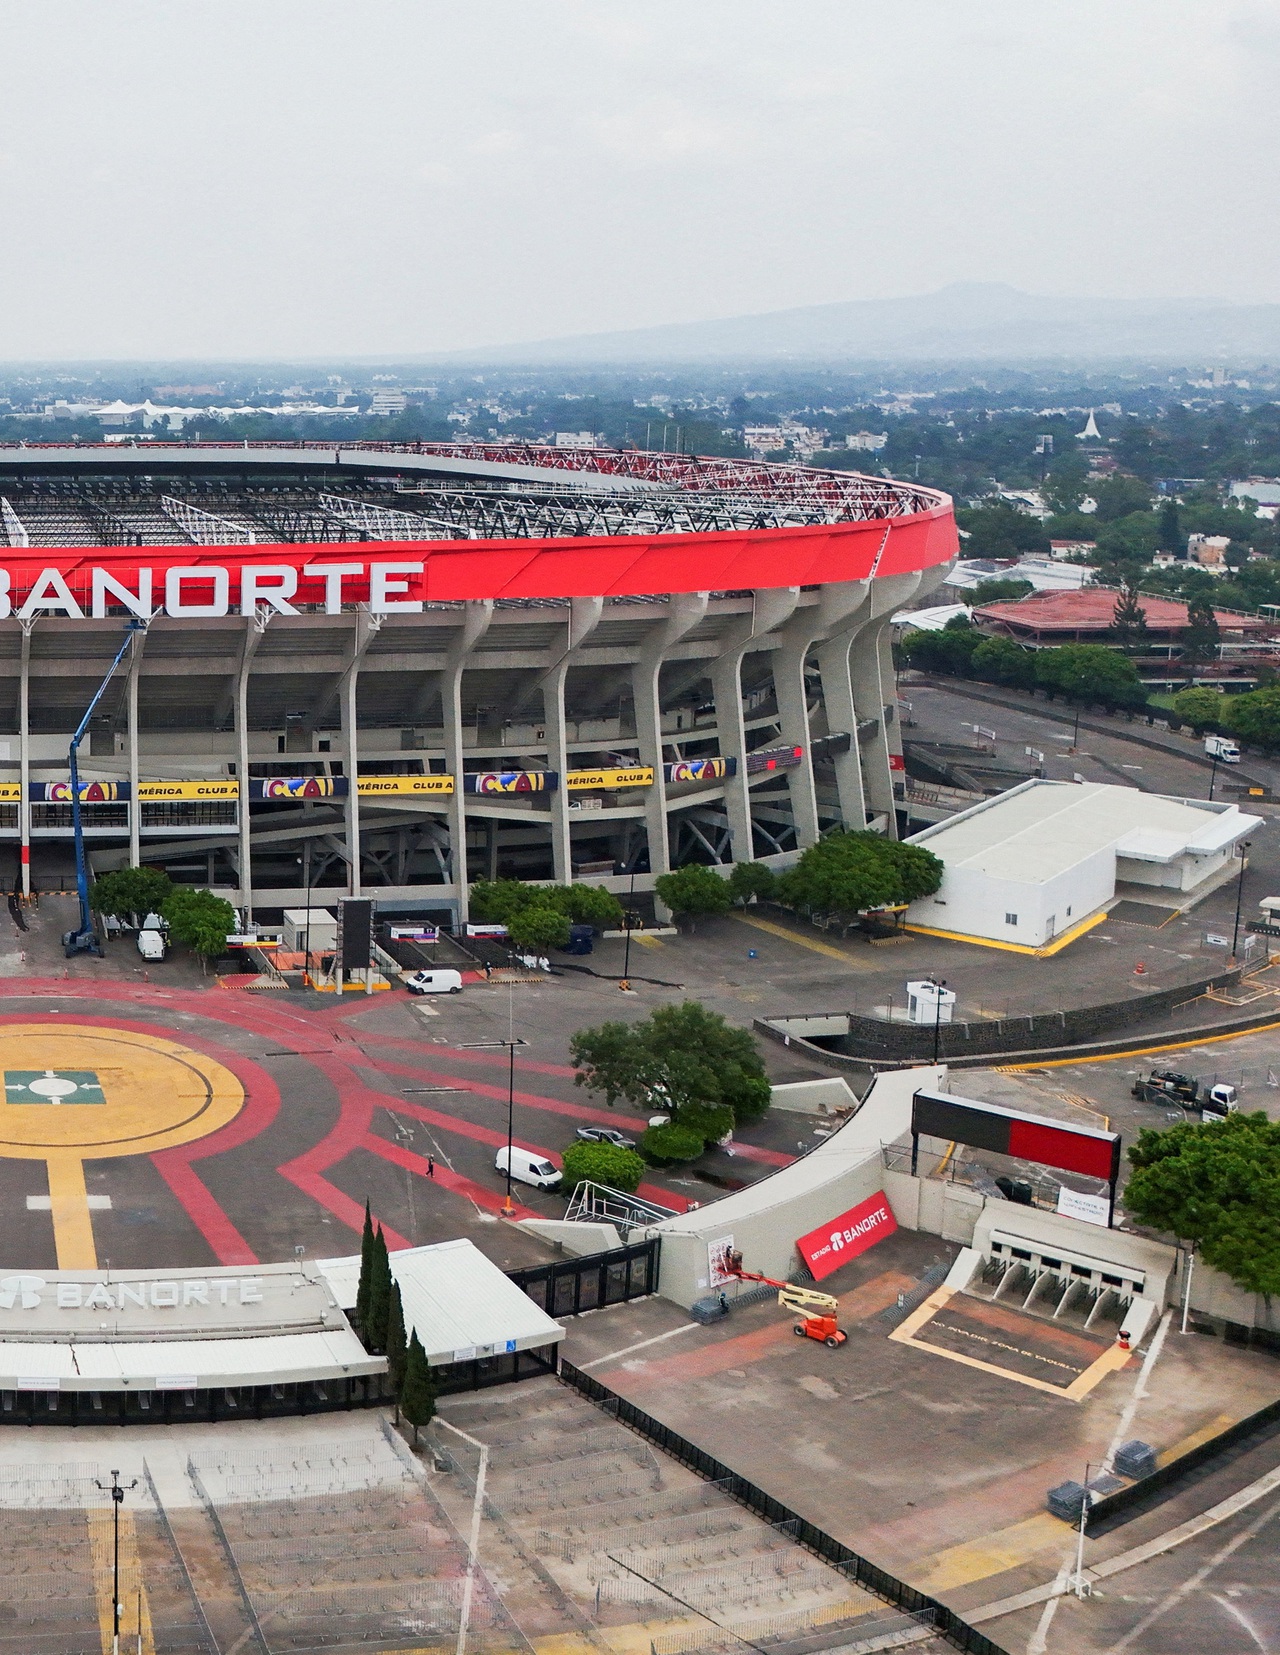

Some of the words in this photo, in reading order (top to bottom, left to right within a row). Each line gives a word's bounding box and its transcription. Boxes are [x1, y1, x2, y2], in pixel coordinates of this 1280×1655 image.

[413, 782, 444, 790] CLUB
[616, 774, 643, 782] CLUB
[138, 787, 183, 796] MÉRICA
[197, 787, 228, 795] CLUB
[811, 1244, 831, 1261] ESTADIO
[842, 1207, 888, 1244] BANORTE
[55, 1277, 264, 1308] BANORTE
[930, 1320, 946, 1328] NO
[948, 1325, 989, 1343] INVADIR
[991, 1340, 1019, 1353] ZONA
